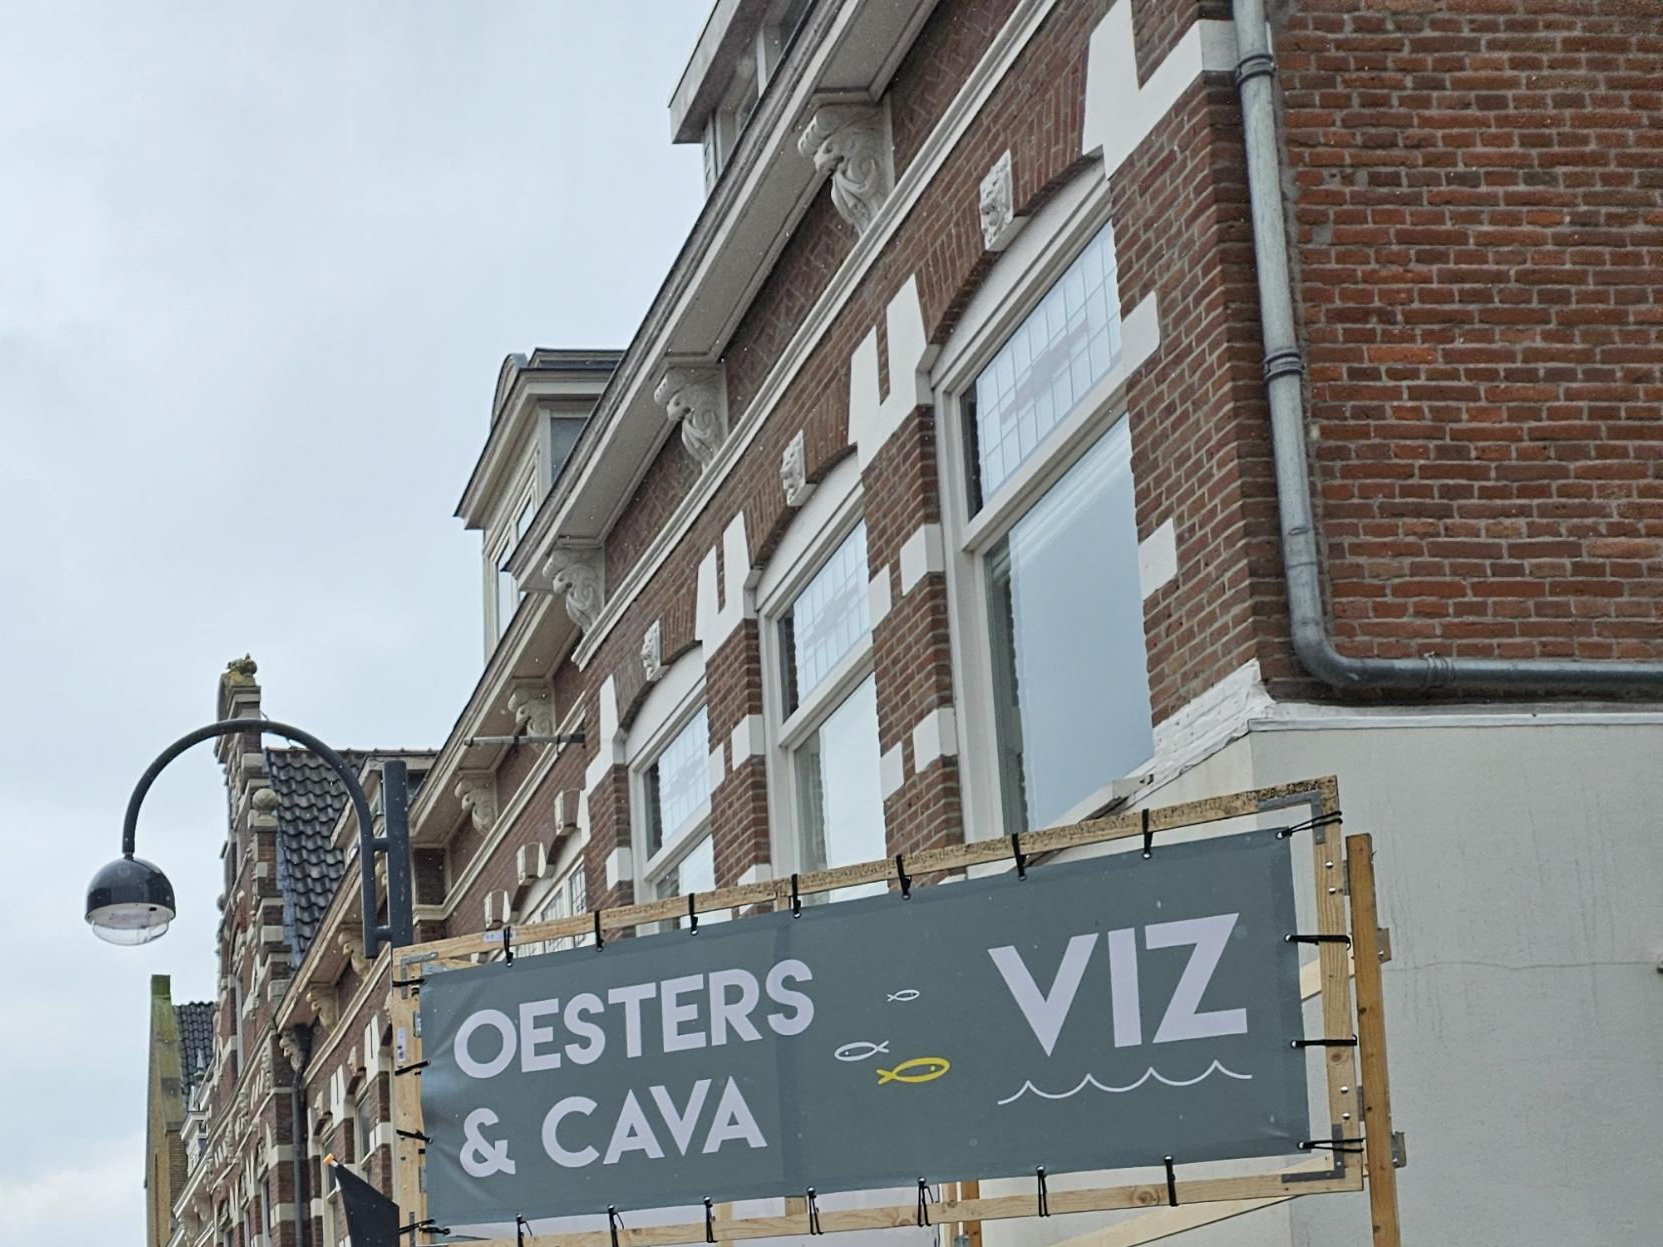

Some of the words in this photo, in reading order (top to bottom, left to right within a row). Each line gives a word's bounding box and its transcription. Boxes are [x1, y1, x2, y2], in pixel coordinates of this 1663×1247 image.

[453, 957, 815, 1080] OESTERS
[988, 912, 1248, 1058] VIZ
[458, 1108, 515, 1178] &
[541, 1074, 768, 1169] CAVA
